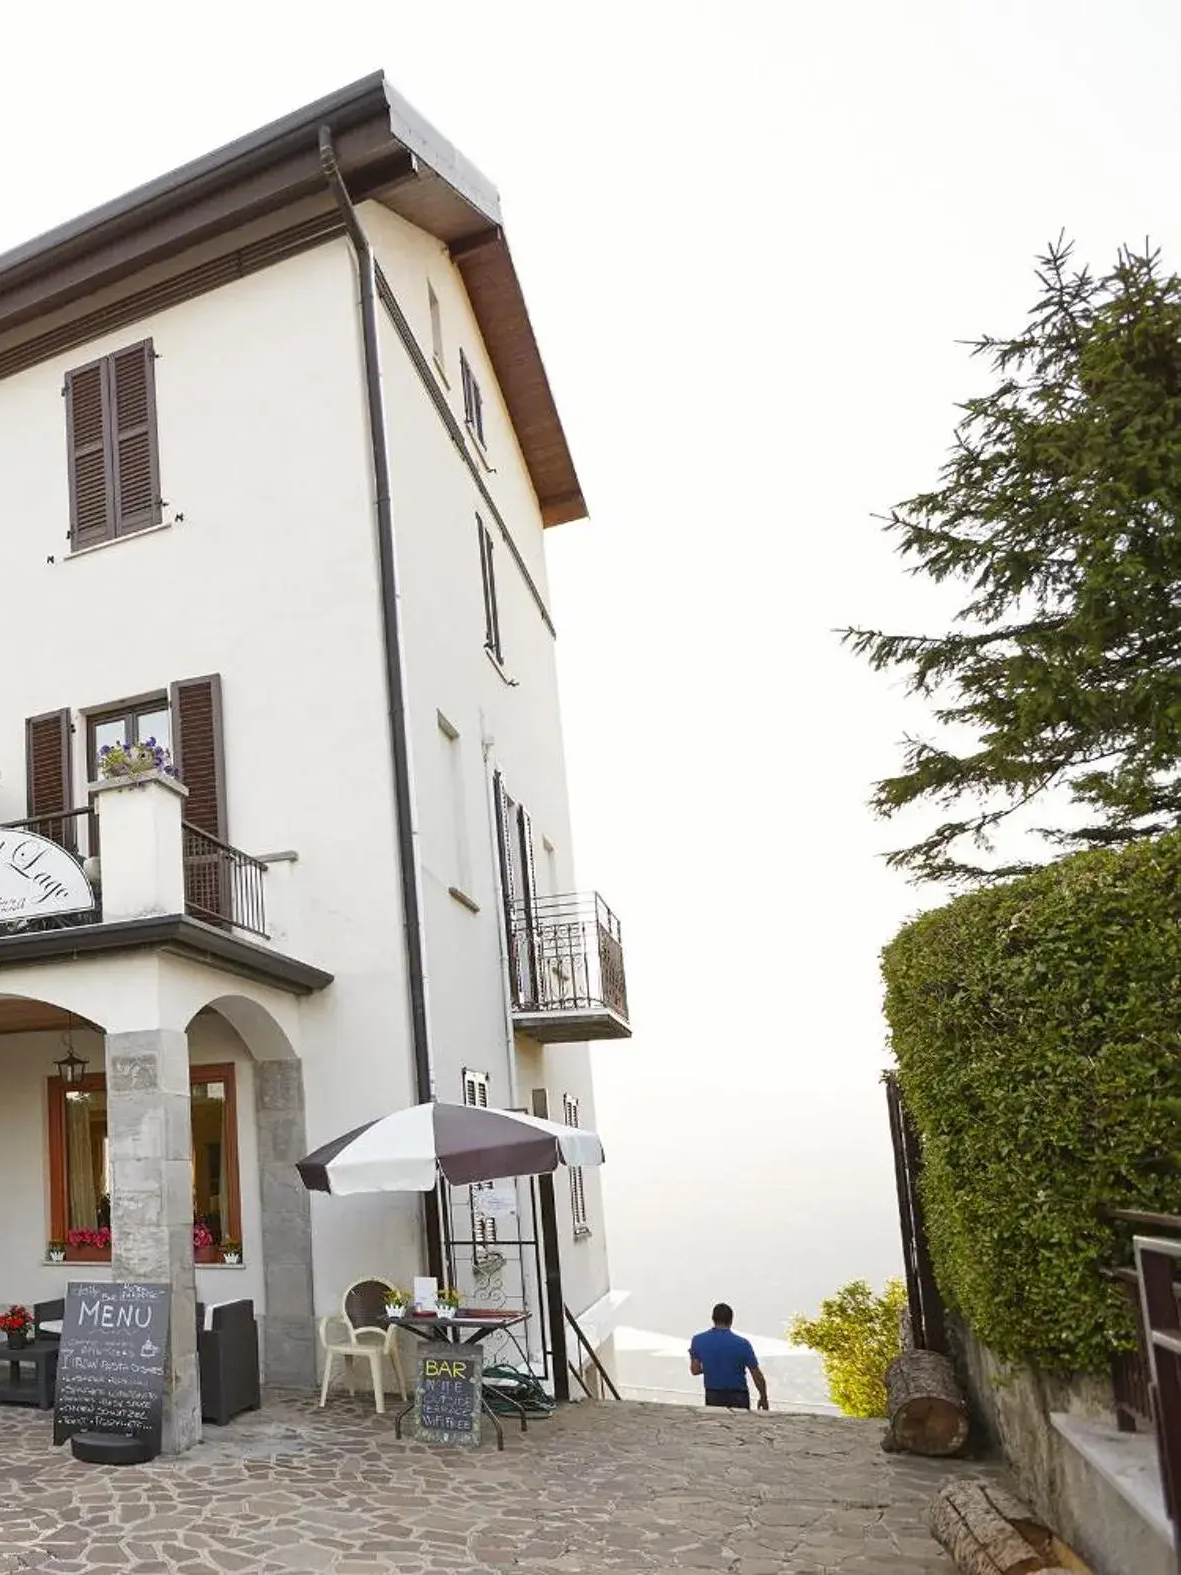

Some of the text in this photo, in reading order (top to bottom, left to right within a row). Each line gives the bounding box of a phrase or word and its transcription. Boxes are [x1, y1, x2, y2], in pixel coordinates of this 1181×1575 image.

[5, 839, 70, 905] Lago
[78, 1300, 153, 1328] MENU
[426, 1360, 467, 1379] BAR
